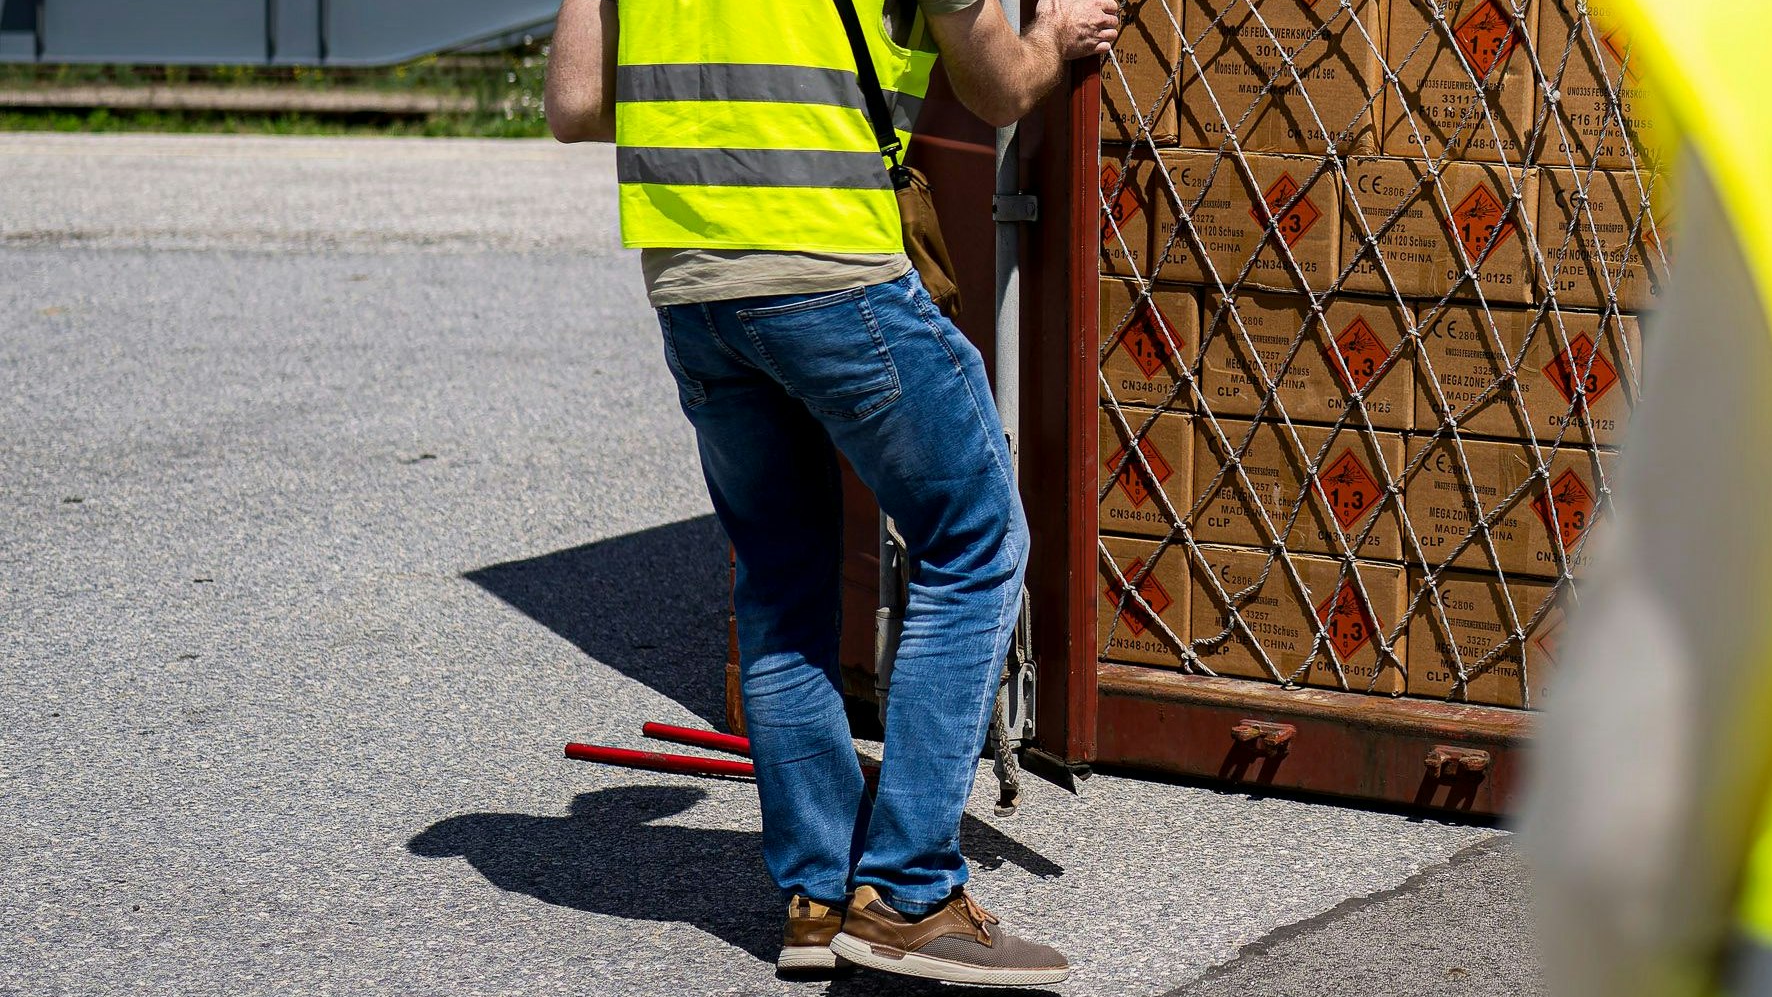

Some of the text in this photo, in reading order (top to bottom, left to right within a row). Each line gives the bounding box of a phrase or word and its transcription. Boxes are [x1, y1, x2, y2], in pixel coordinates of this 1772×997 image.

[1470, 35, 1504, 57] 1.3
[1125, 52, 1138, 64] sec
[1214, 59, 1335, 79] Monster 72 sec
[1238, 83, 1263, 94] MADE
[1567, 86, 1591, 96] UN0335
[1570, 114, 1590, 126] F16
[1204, 122, 1226, 133] CLP
[1358, 174, 1405, 197] CE 2806
[1204, 224, 1245, 238] 120 Schuss
[1461, 223, 1497, 243] 1.3
[1209, 240, 1241, 253] CHINA
[1394, 235, 1437, 249] 120 Schuss
[1165, 254, 1187, 264] CLP
[1386, 250, 1433, 263] IN CHINA
[1353, 263, 1377, 274] CLP
[1242, 316, 1264, 326] 2806
[1458, 331, 1481, 341] 2806
[1440, 373, 1486, 388] MEGA ZONE
[1217, 386, 1240, 397] CLP
[1446, 390, 1478, 402] MADE
[1330, 488, 1364, 510] 1.3
[1109, 507, 1169, 524] CN348-0125
[1429, 506, 1451, 520] MEGA
[1207, 517, 1230, 527] CLP
[1434, 523, 1465, 536] MADE
[1421, 536, 1445, 547] CLP
[1231, 575, 1253, 586] 2806
[1452, 600, 1475, 611] 2806
[1245, 609, 1270, 621] 33257
[1258, 621, 1299, 639] 133 Schuss
[1329, 619, 1363, 642] 1.3
[1109, 636, 1170, 655] CN348-0125
[1263, 638, 1296, 652] CHINA
[1466, 635, 1492, 646] 33257
[1457, 645, 1480, 658] ZONE
[1426, 671, 1450, 682] CLP
[1487, 665, 1520, 678] CHINA
